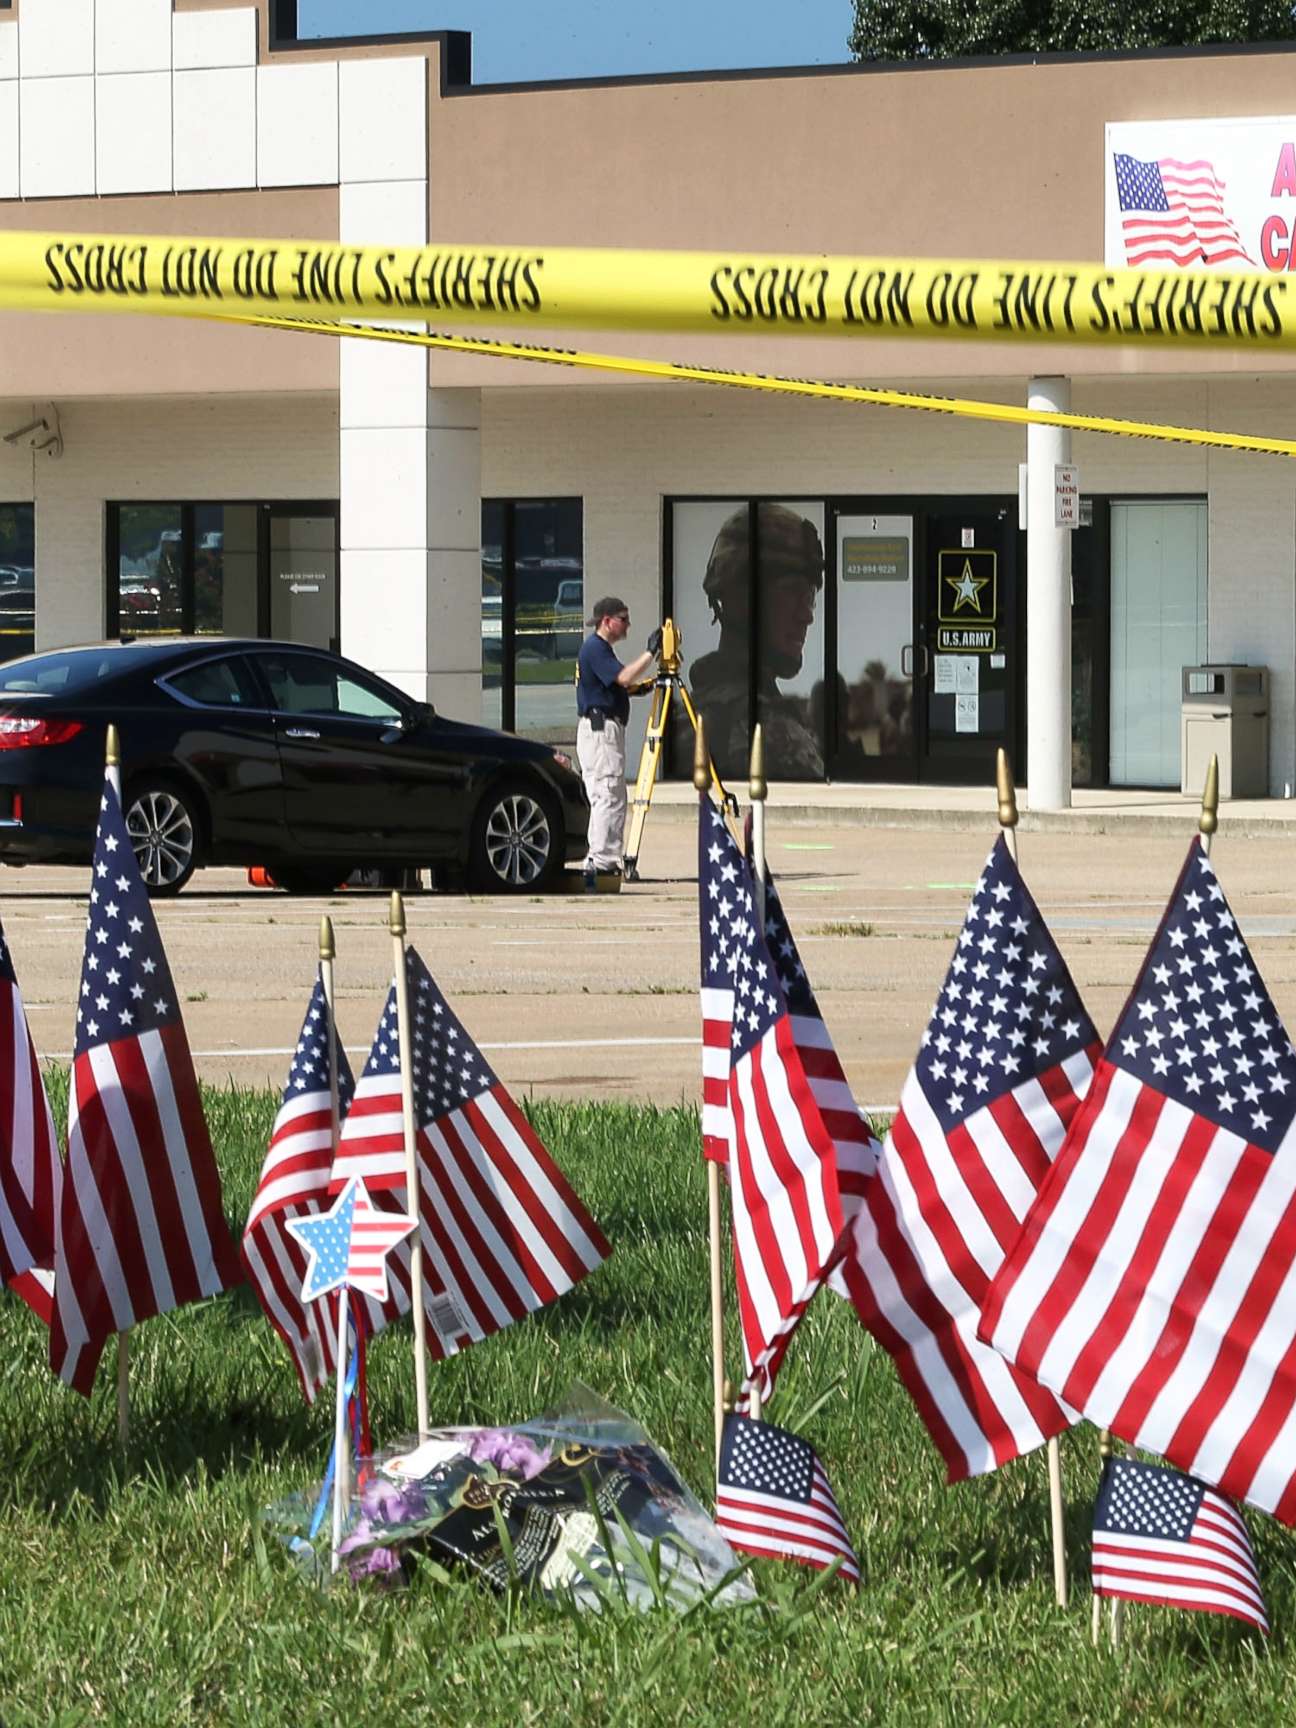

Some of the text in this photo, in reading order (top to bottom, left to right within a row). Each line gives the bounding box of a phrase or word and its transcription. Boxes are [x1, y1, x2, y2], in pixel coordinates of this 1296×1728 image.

[44, 243, 544, 312] SHERIFF'S LINE DO NOT CROSS
[709, 266, 1287, 340] SHERIFF'S LINE DO NOT CROSS
[1063, 473, 1071, 482] NO
